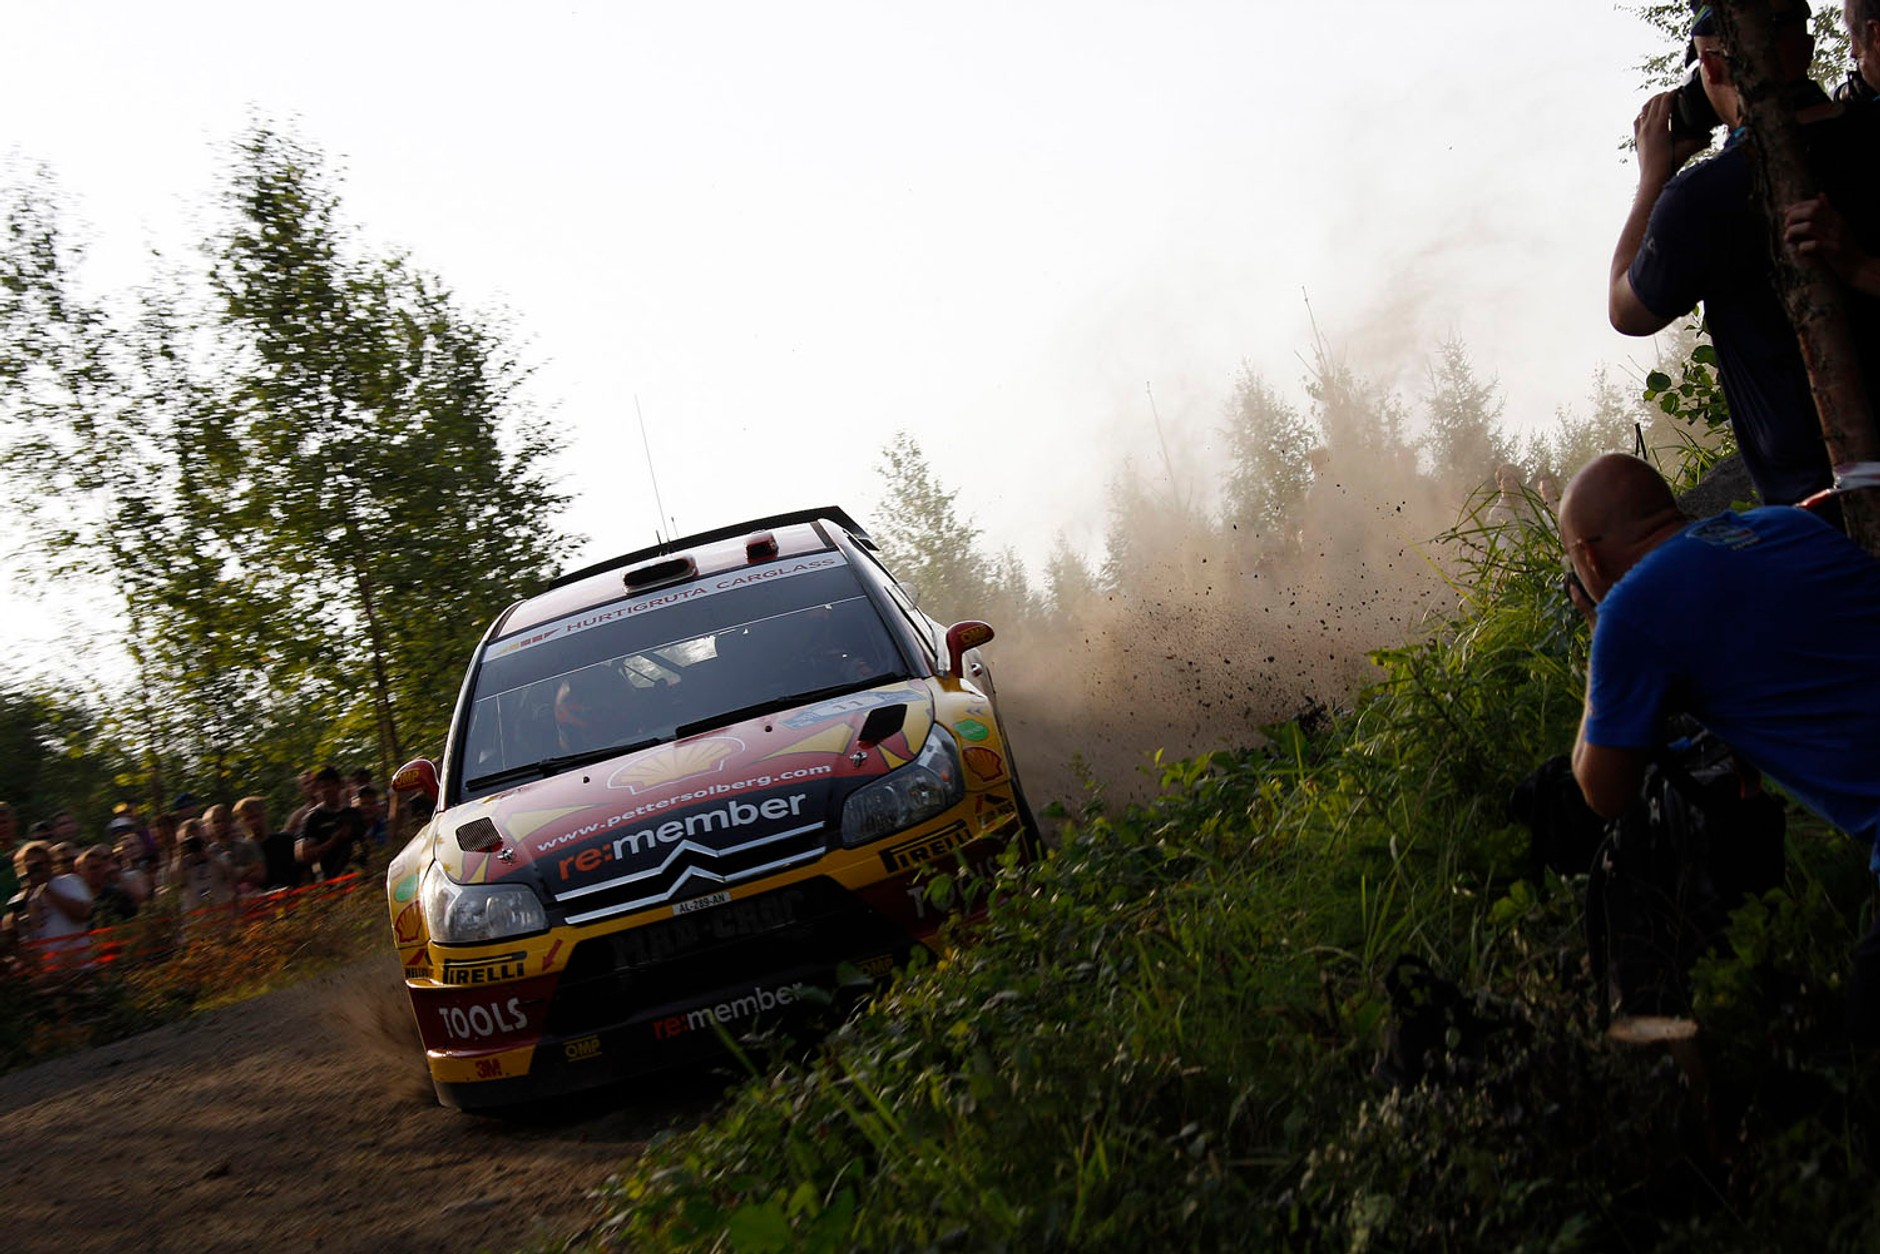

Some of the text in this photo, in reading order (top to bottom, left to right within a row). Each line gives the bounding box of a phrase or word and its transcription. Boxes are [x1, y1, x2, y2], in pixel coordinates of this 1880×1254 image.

[567, 558, 835, 633] HURTIGRUTA CARGLASS
[537, 763, 832, 851] www.pettersolberg.com
[559, 793, 807, 880] re:member
[443, 950, 527, 984] PIRELLI
[438, 997, 528, 1040] TOOLS
[475, 1059, 502, 1078] 3M
[563, 1037, 602, 1059] OMP
